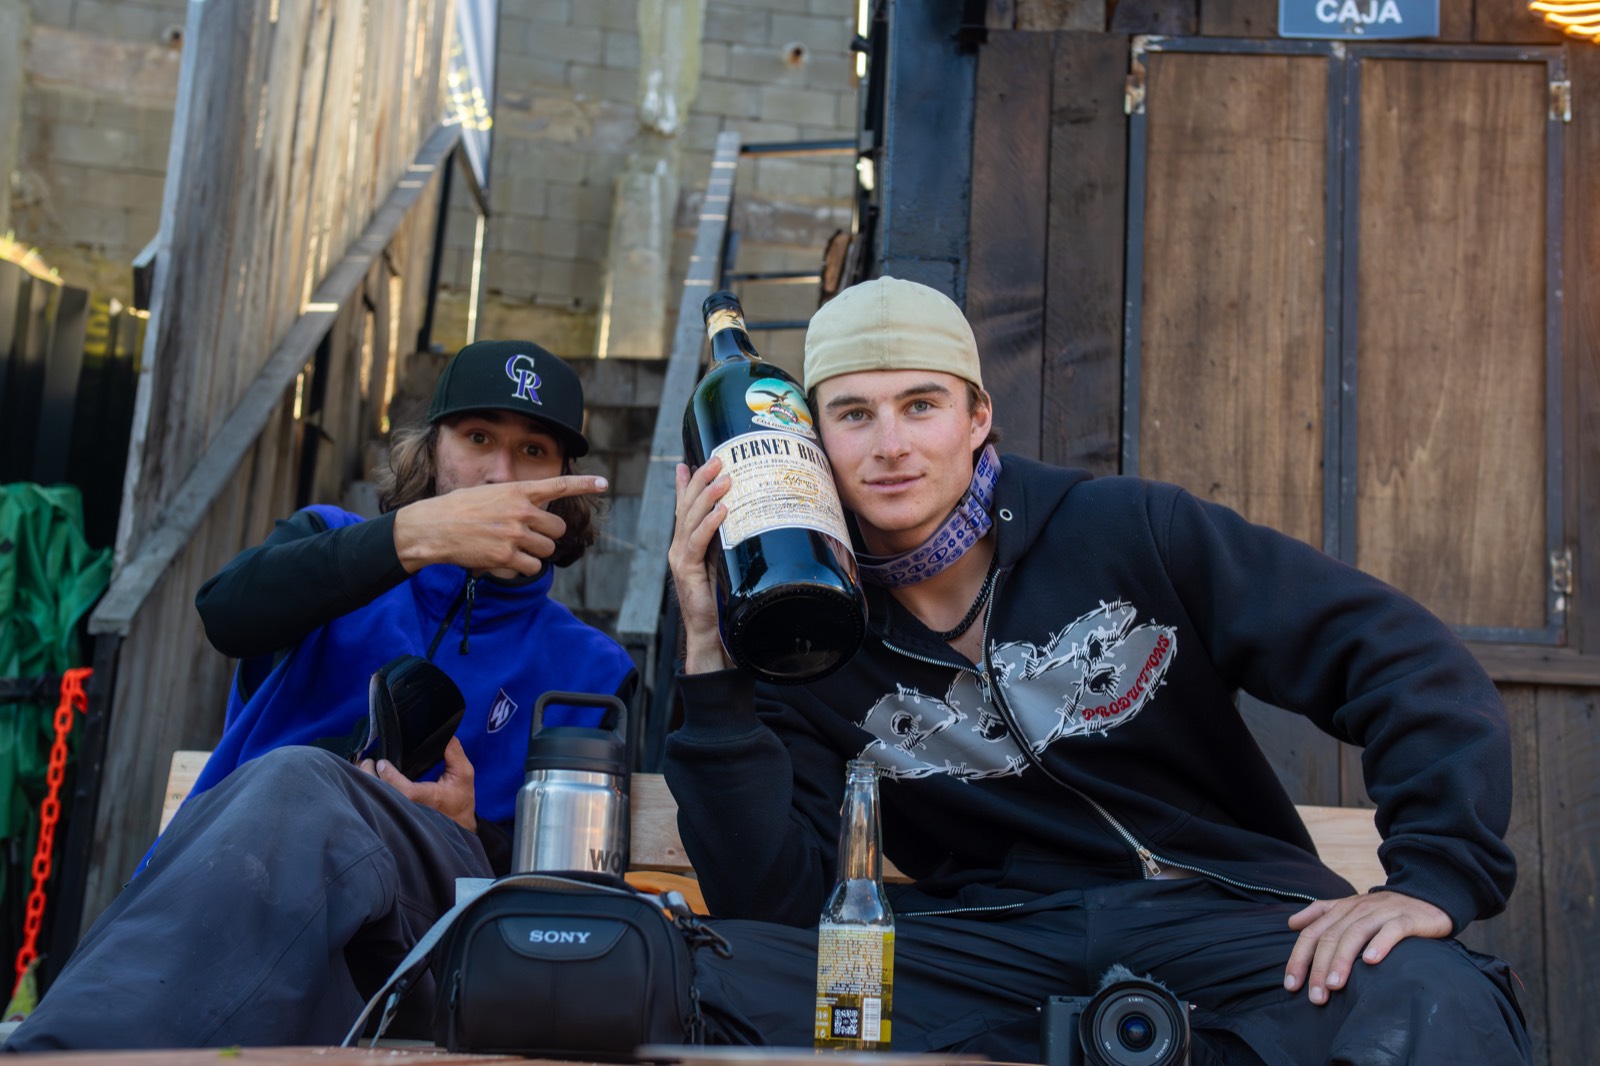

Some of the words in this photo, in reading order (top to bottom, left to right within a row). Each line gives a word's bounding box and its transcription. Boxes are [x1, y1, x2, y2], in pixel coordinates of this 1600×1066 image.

[1315, 0, 1403, 24] CAJA
[731, 438, 790, 464] FERNET
[1082, 634, 1170, 721] PRODUCTIONS
[529, 929, 591, 944] SONY
